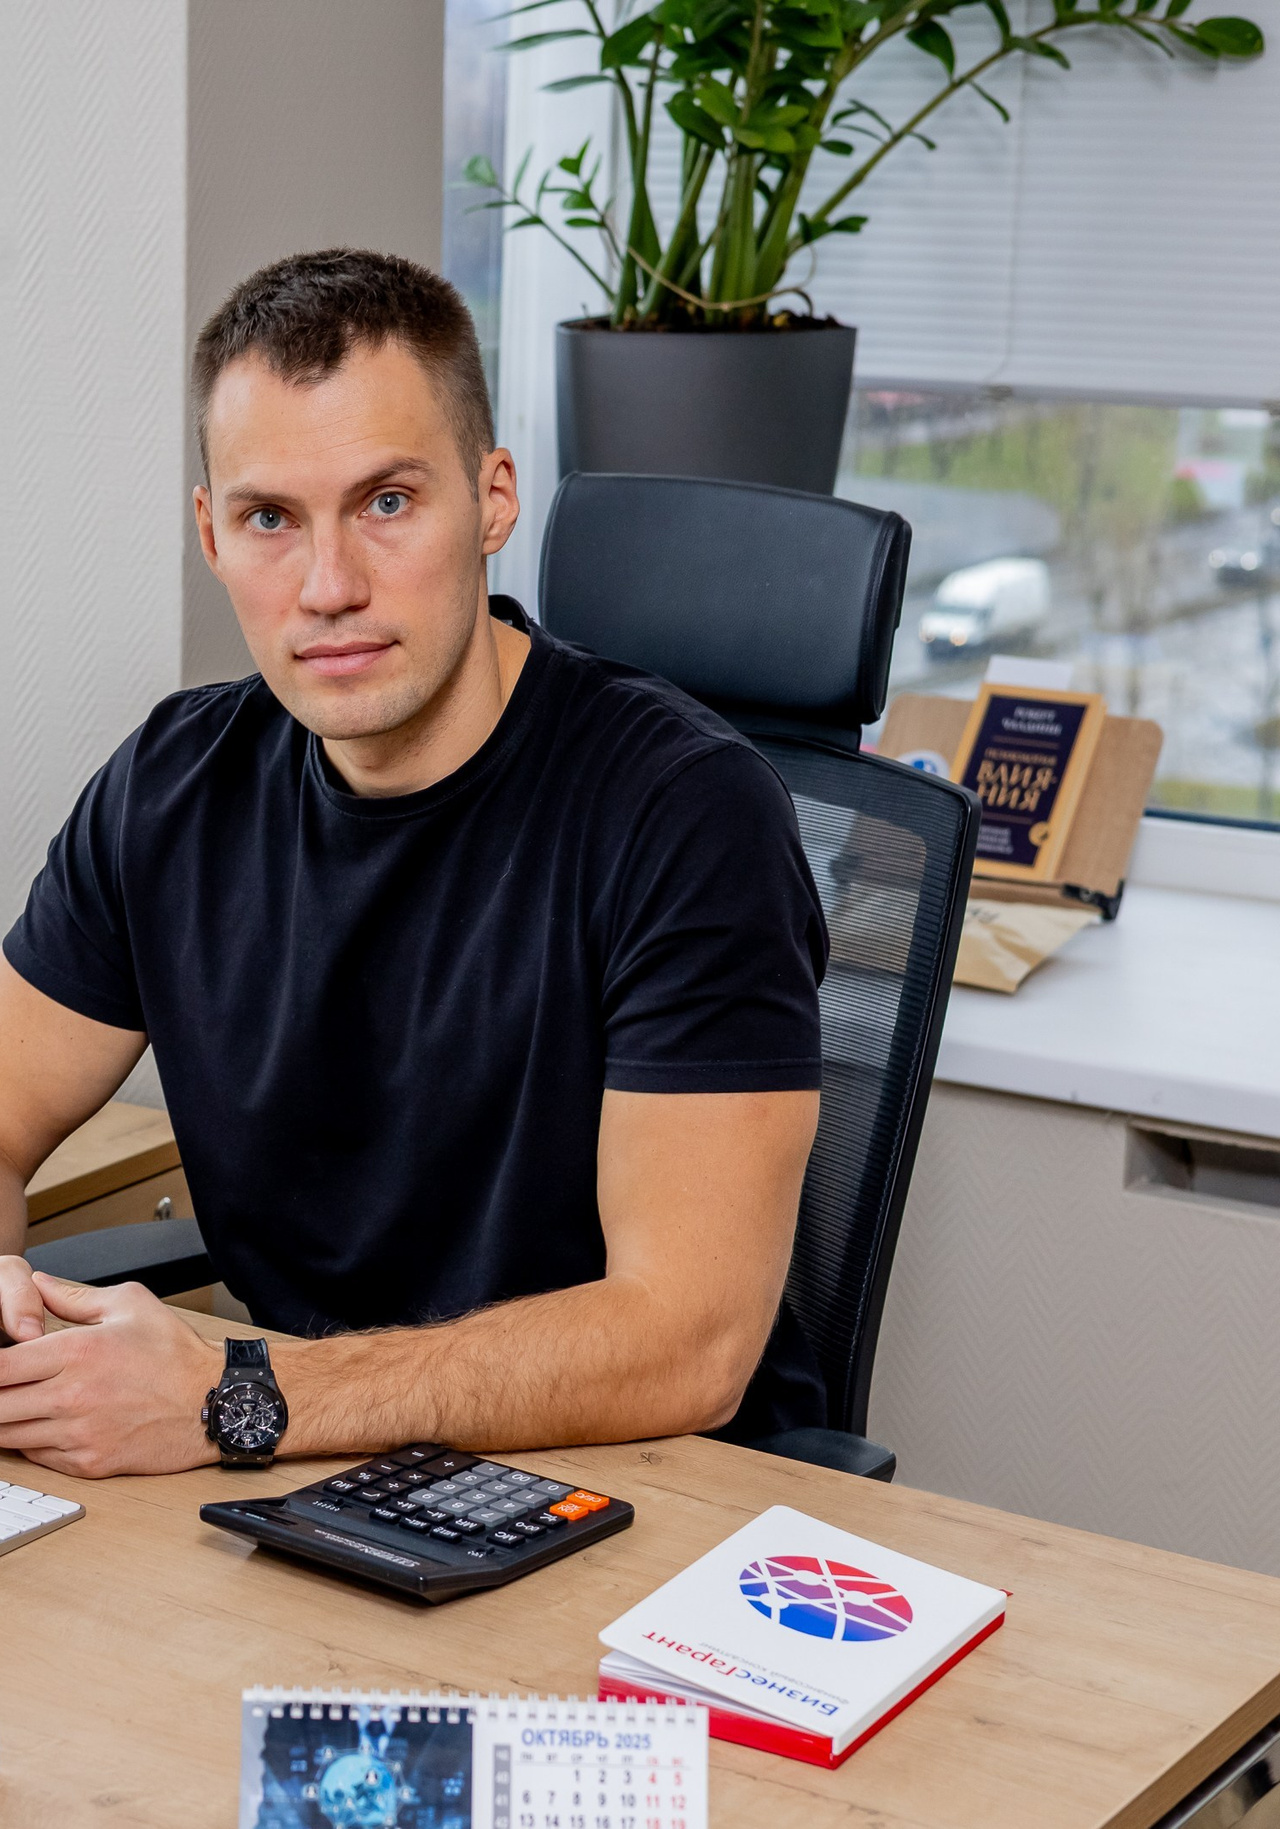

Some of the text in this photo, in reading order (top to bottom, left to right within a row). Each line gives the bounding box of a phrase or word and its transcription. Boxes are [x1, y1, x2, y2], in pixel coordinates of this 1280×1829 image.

[643, 1632, 840, 1717] БизнесГарант
[521, 1728, 651, 1749] ОКТЯБРЬ 2025
[574, 1769, 580, 1782] 1
[598, 1770, 606, 1783] 2
[623, 1771, 631, 1784] 3
[648, 1772, 656, 1784] 4
[523, 1790, 530, 1804] 6
[548, 1791, 555, 1804] 7
[573, 1792, 581, 1806] 8
[598, 1792, 606, 1806] 9
[621, 1794, 636, 1807] 10
[646, 1795, 659, 1808] 11
[671, 1795, 686, 1809] 12
[520, 1813, 534, 1827] 13
[545, 1814, 559, 1827] 14
[571, 1815, 584, 1828] 15
[596, 1815, 610, 1829] 16
[621, 1816, 635, 1829] 17
